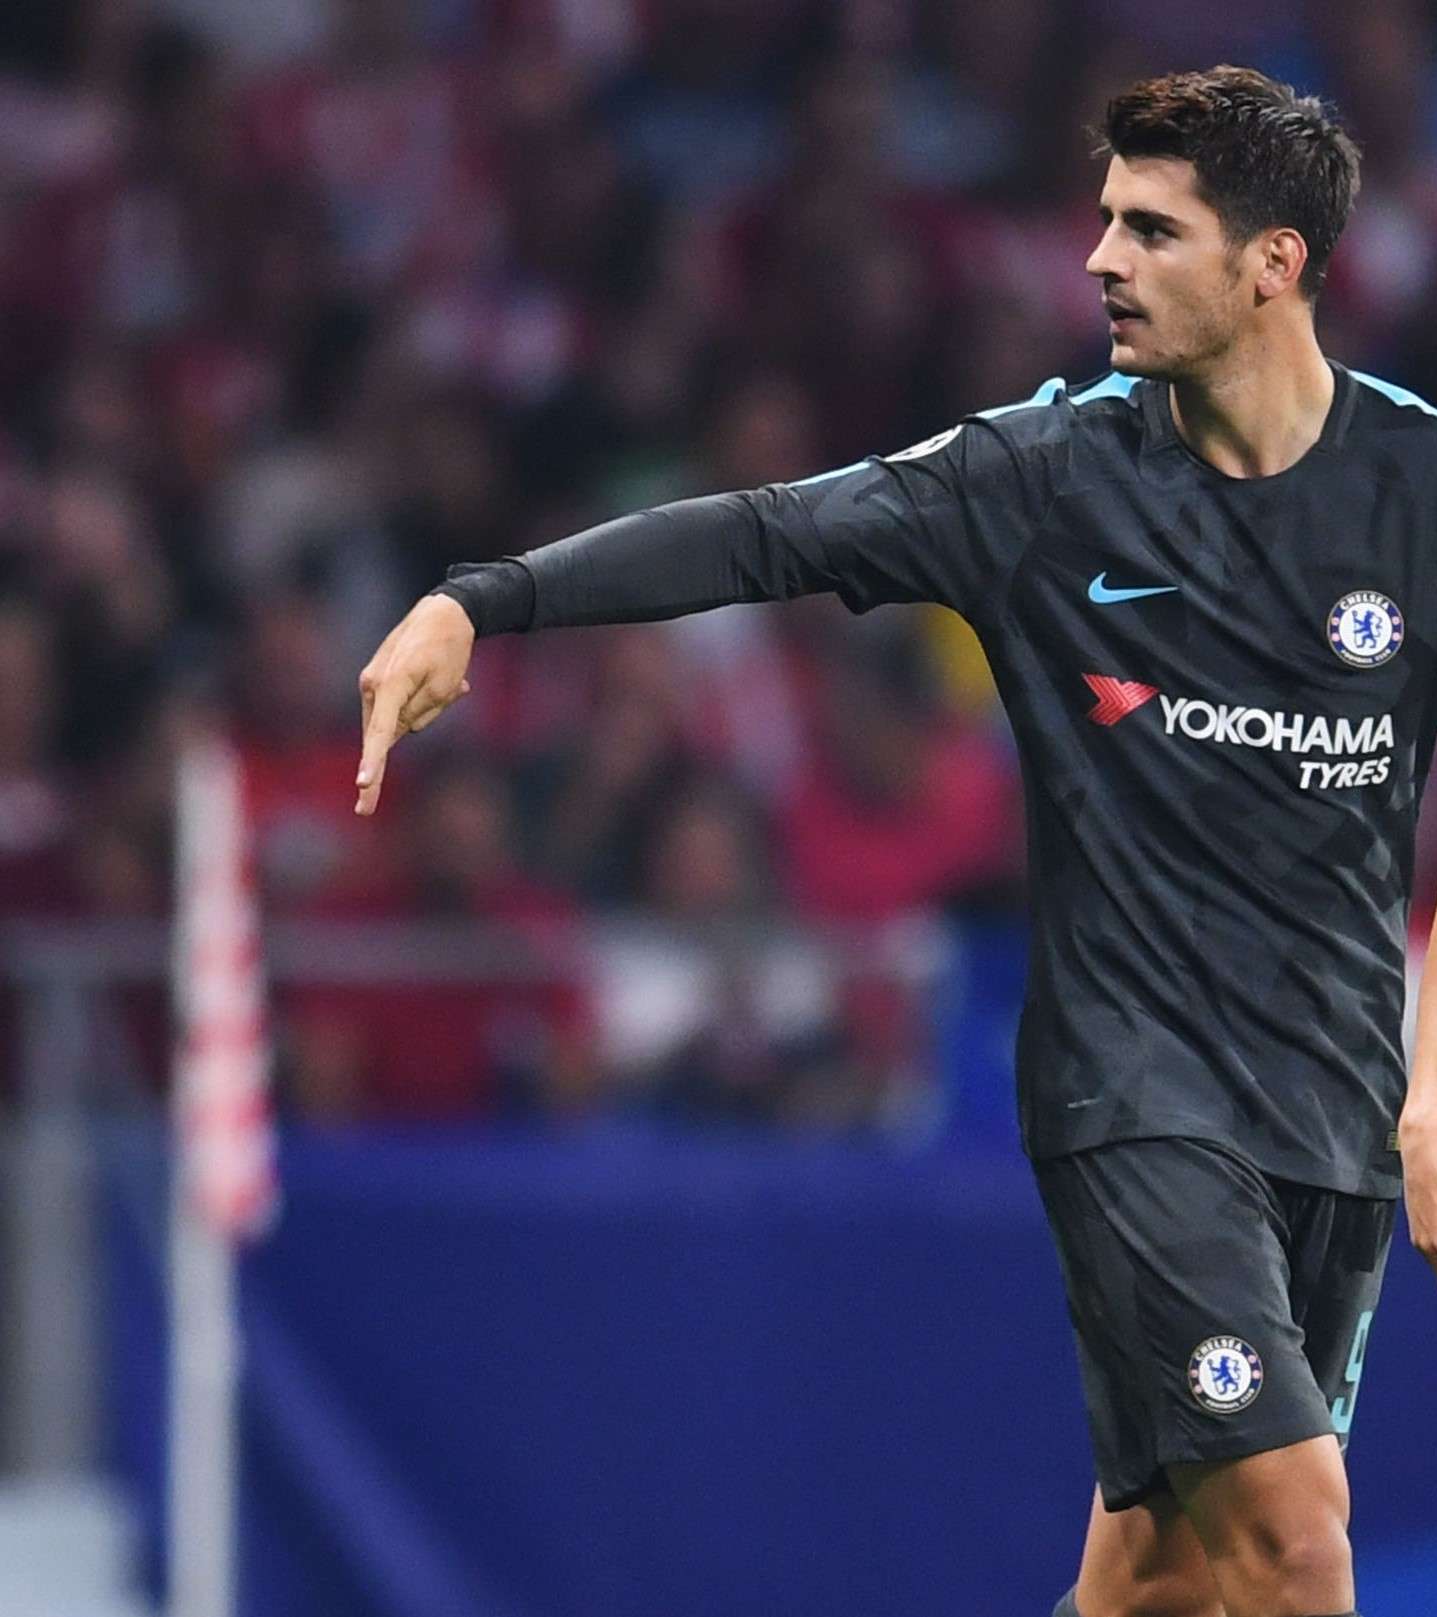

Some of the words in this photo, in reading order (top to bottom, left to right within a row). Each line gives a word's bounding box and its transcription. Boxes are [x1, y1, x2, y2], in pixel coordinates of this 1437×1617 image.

[1340, 593, 1390, 610] CHELSEA
[1159, 694, 1394, 755] YOKOHAMA
[1299, 756, 1391, 789] TYRES
